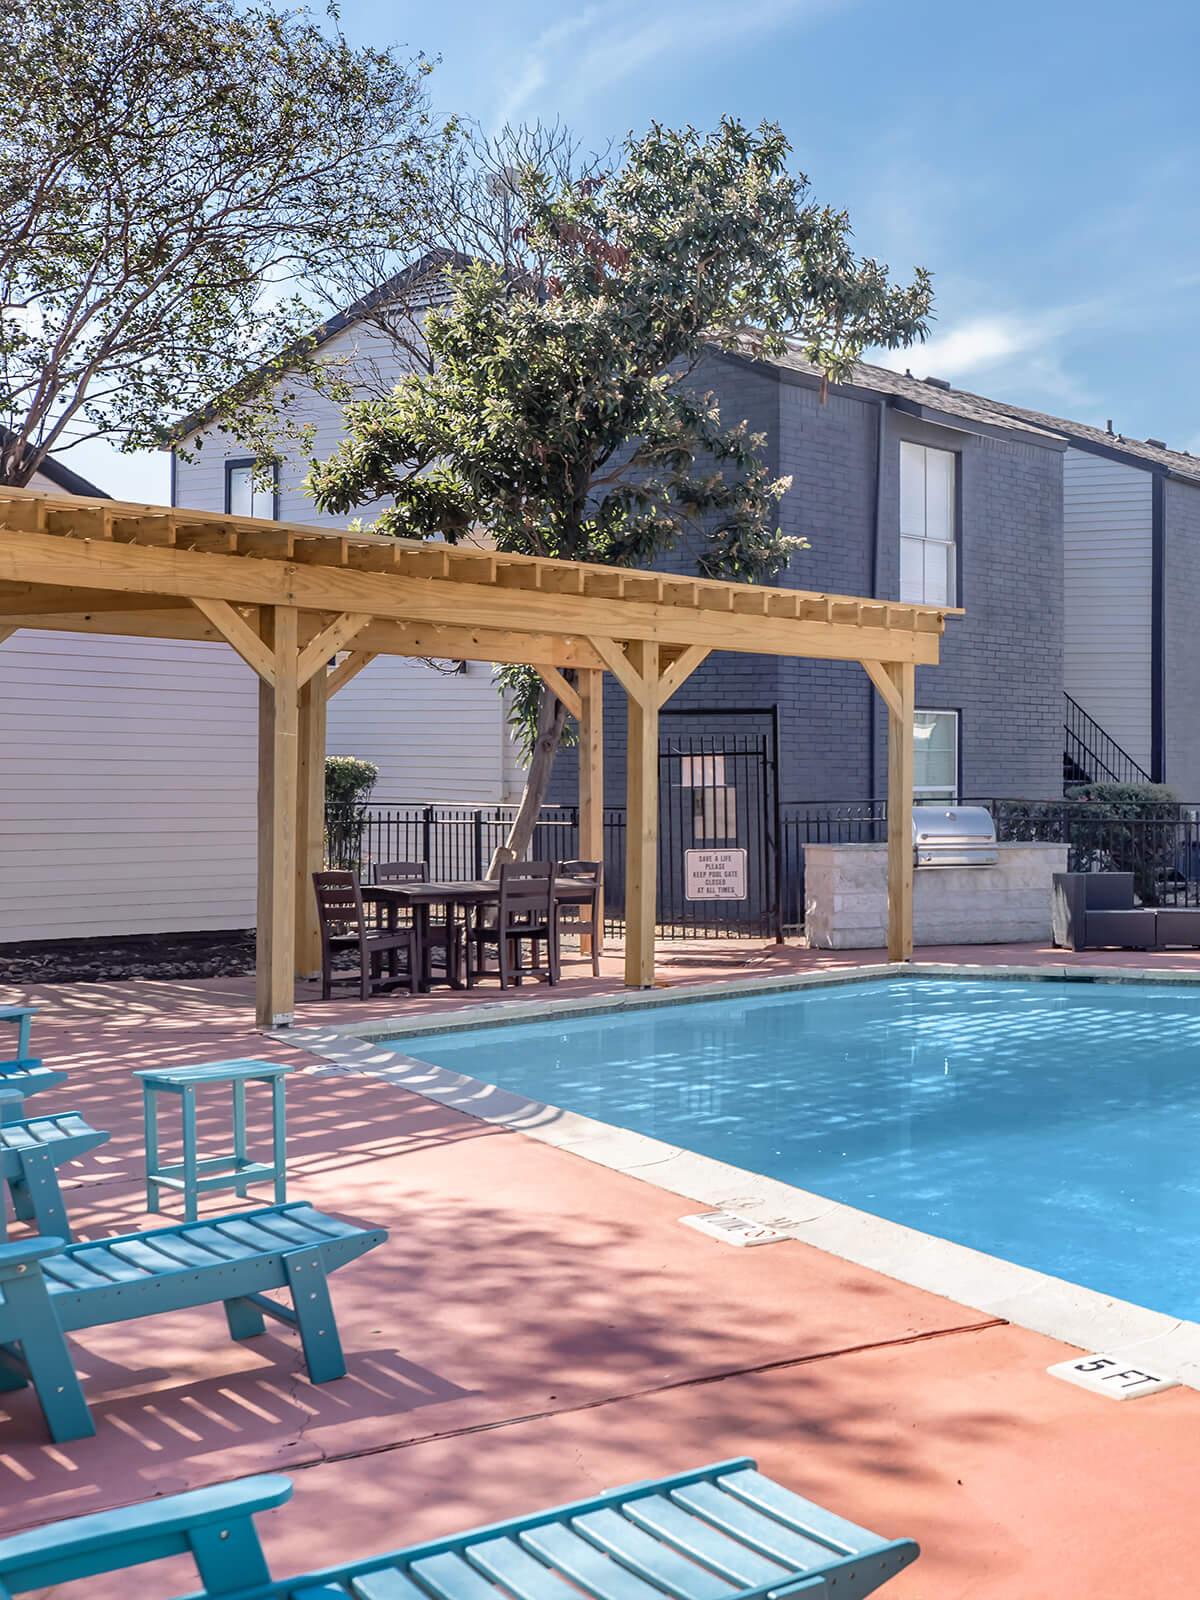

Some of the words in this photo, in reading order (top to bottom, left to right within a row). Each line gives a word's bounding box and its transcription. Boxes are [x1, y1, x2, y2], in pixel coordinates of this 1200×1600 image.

[693, 871, 706, 879] KEEP
[718, 886, 735, 894] TIMES
[1073, 1358, 1117, 1373] 5
[1100, 1369, 1162, 1388] FT
